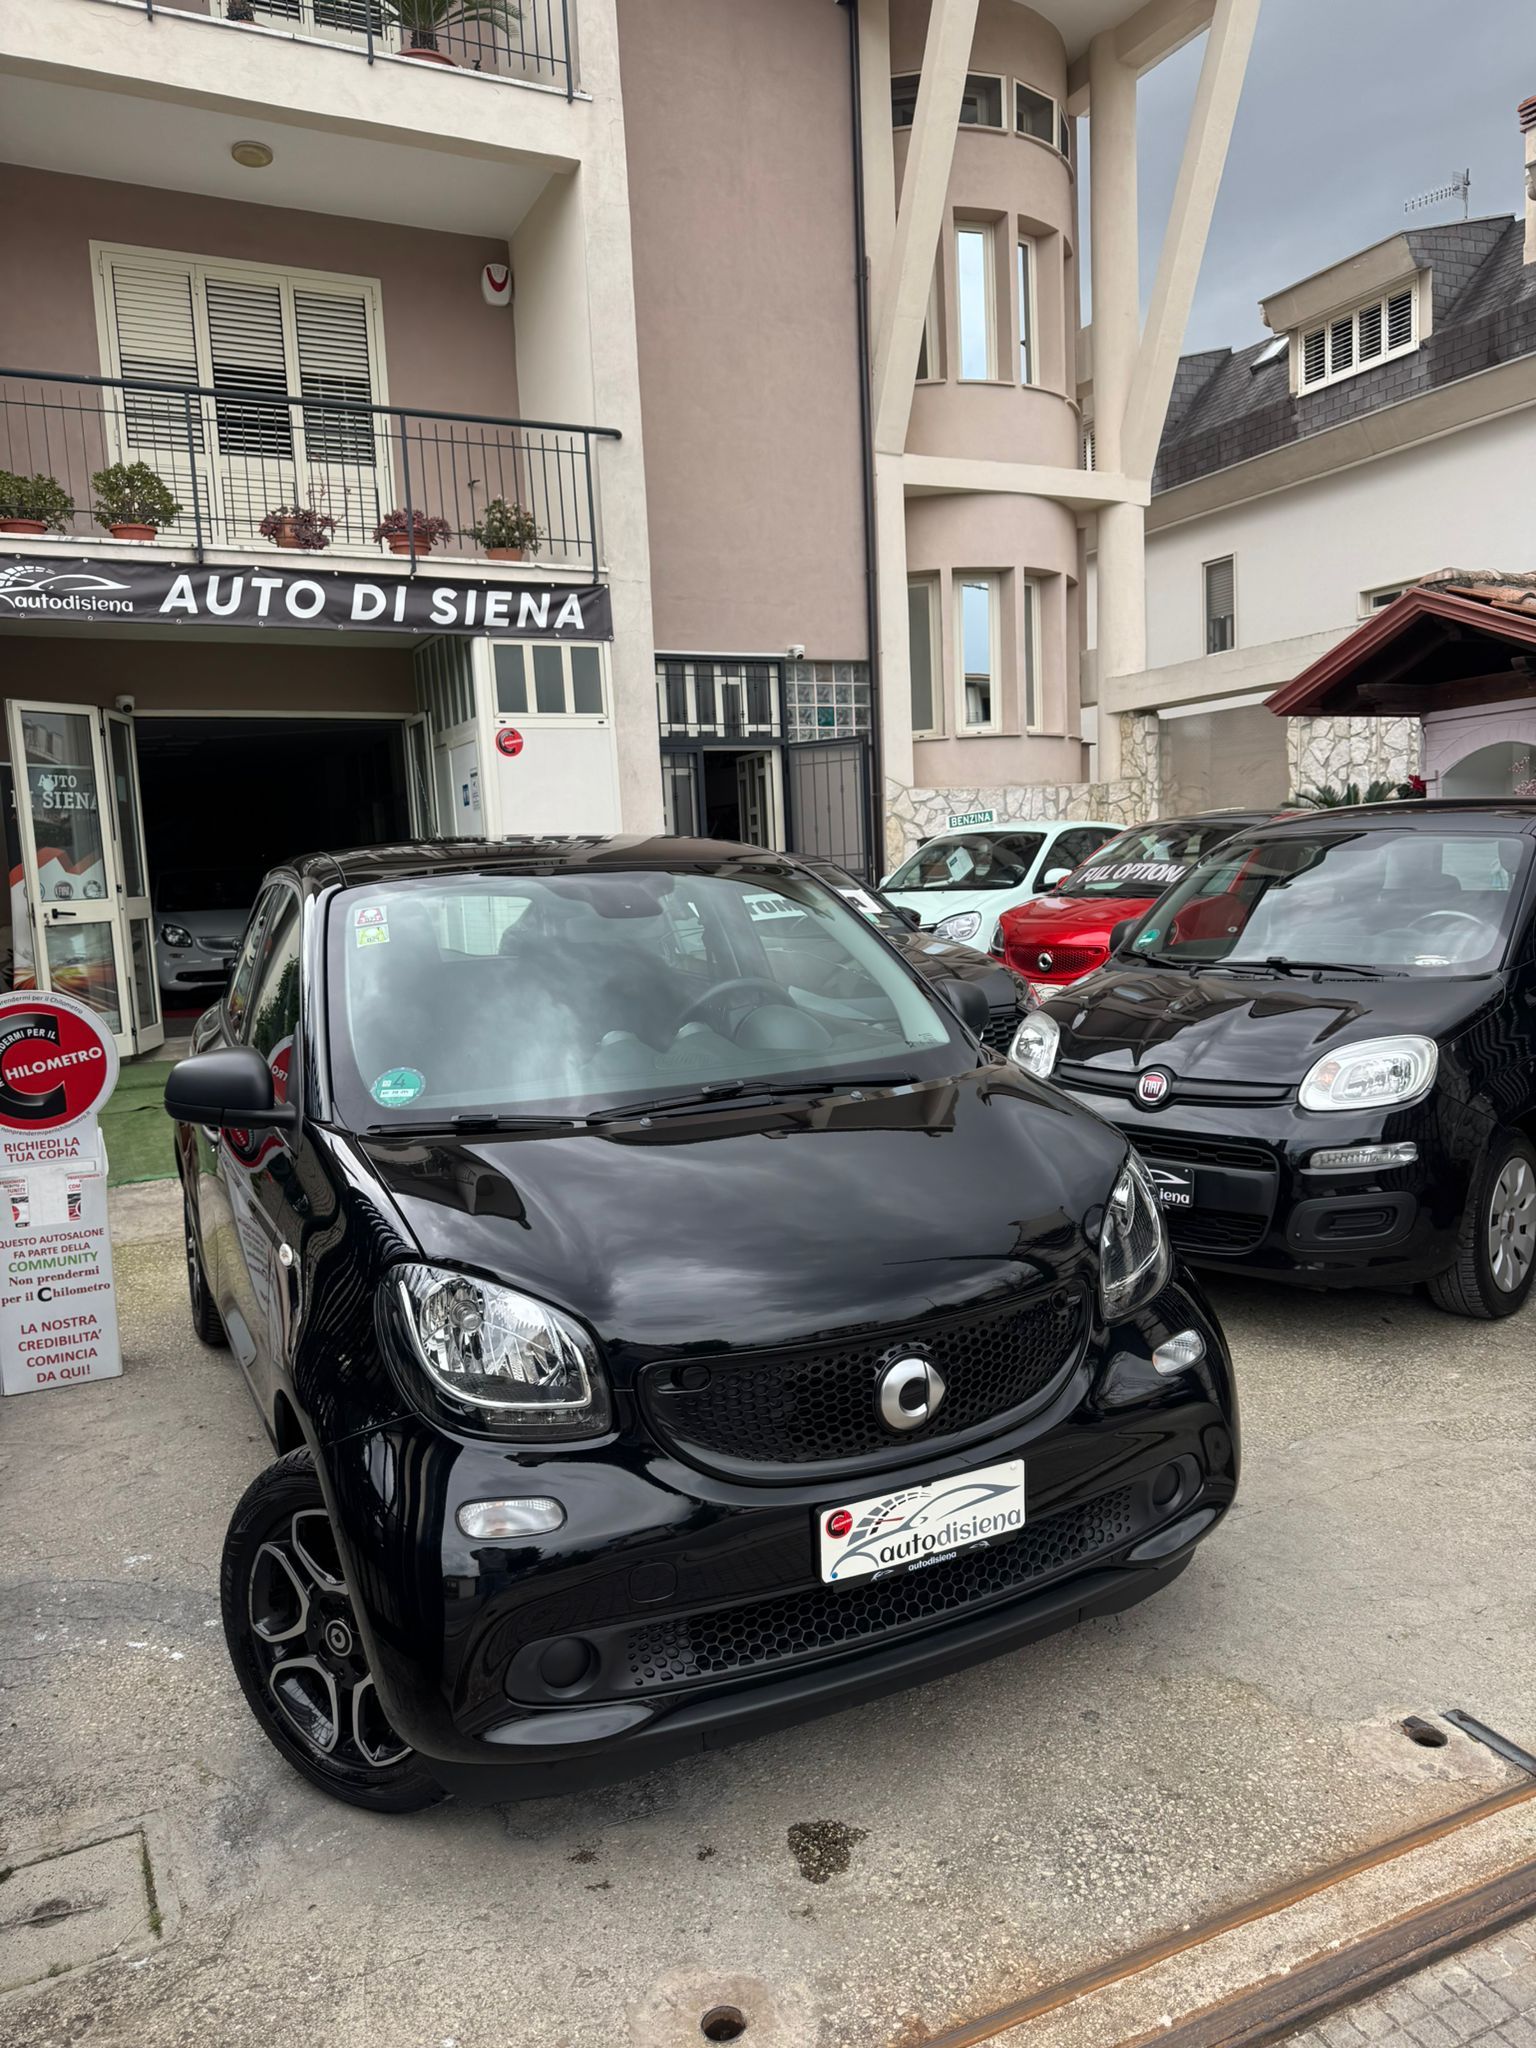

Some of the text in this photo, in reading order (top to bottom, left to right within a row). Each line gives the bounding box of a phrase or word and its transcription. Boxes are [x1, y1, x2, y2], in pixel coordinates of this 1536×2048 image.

[14, 593, 134, 613] autodisiena
[159, 574, 585, 630] AUTO DI SIENA
[38, 774, 77, 791] AUTO
[951, 812, 991, 827] BENZINA
[1077, 862, 1188, 884] FULL OPTION
[0, 1028, 56, 1055] DERMI PER IL
[393, 1072, 406, 1088] 4
[1144, 1079, 1162, 1095] FIAT
[4, 1137, 80, 1153] RICHIEDI LA
[7, 1147, 79, 1163] TUA COPIA
[0, 1227, 105, 1249] QUESTO AUTOSALONE
[13, 1242, 91, 1259] FA PARTE DELLA
[8, 1251, 98, 1273] COMMUNITY
[9, 1265, 100, 1287] Non prendermi
[1, 1282, 111, 1308] per il Chilometro
[20, 1314, 97, 1335] LA NOSTRA
[26, 1347, 98, 1368] COMINCIA
[36, 1363, 91, 1384] DA QUI!
[880, 1508, 1021, 1563] autodisiena
[908, 1551, 957, 1571] autodisiena
